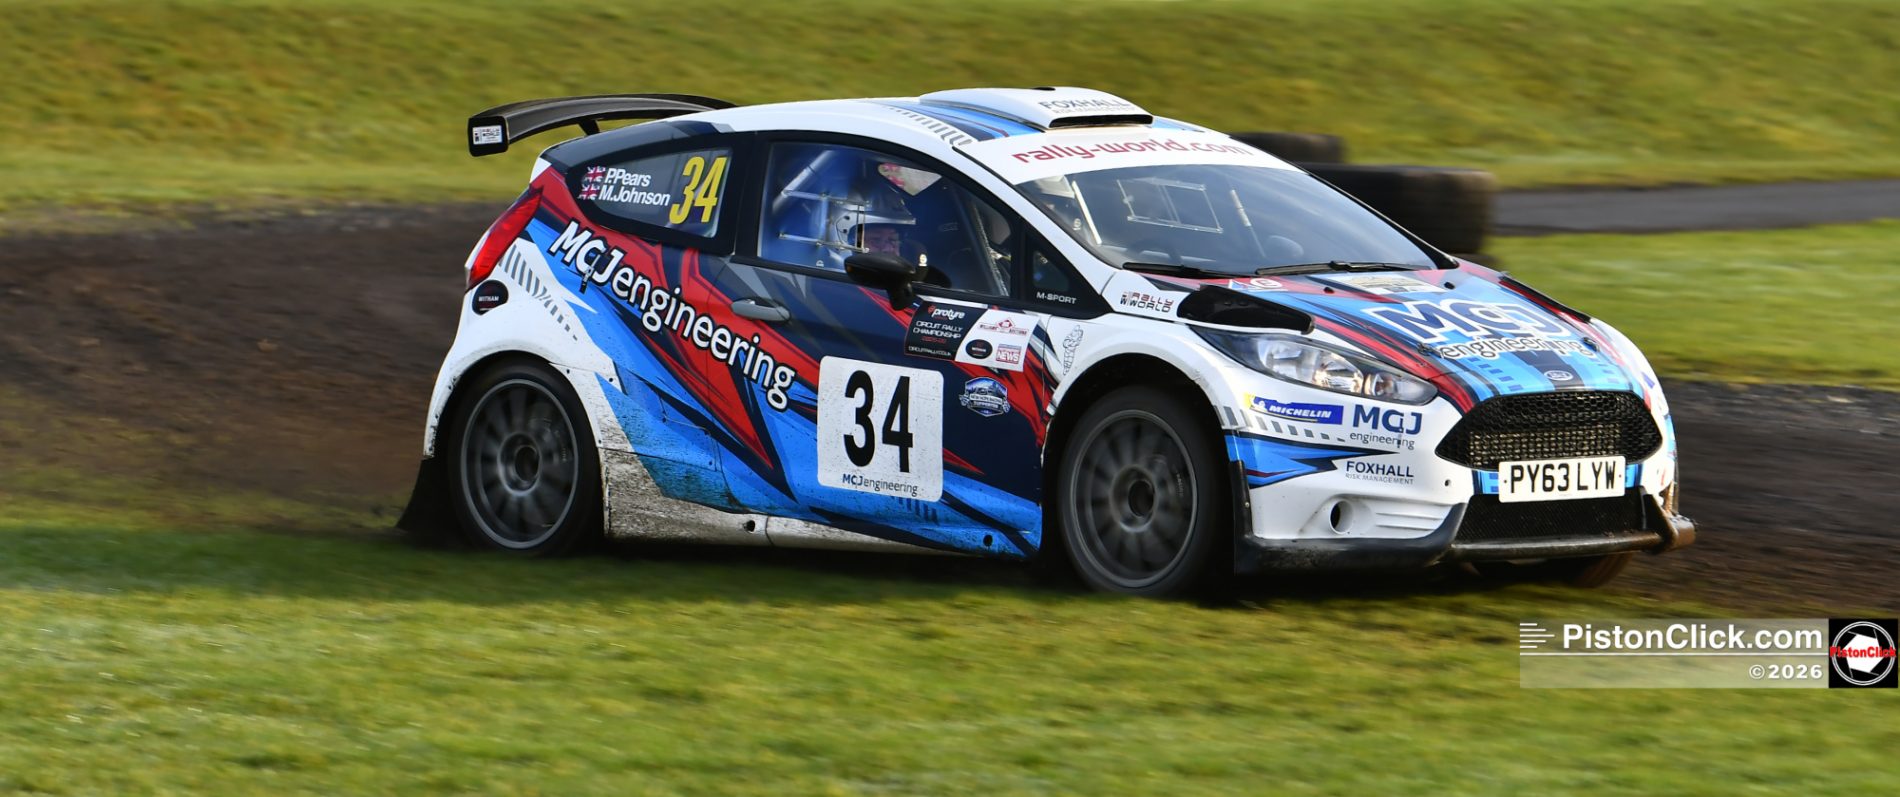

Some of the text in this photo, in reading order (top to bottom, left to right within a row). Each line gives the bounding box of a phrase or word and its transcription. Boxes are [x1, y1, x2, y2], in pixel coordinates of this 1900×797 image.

[1038, 99, 1131, 110] FOXHALL
[1012, 138, 1255, 163] rally-world.com
[604, 167, 652, 187] P.Pears
[598, 183, 671, 207] M.Johnson
[669, 155, 728, 225] 34
[1036, 291, 1078, 305] M-SPORT
[1129, 300, 1172, 313] WORLD
[931, 307, 966, 321] protyre
[1370, 302, 1568, 342] MCJ
[912, 327, 962, 339] CHAMPIONSHIP
[915, 320, 964, 332] CIRCUIT RALLY
[997, 349, 1020, 362] NEWS
[1439, 337, 1594, 359] engineering
[1268, 404, 1332, 419] MICHELIN
[1352, 403, 1422, 433] MCJ
[843, 371, 914, 472] 34
[1349, 431, 1415, 450] engineering
[1346, 460, 1414, 478] FOXHALL
[1509, 460, 1616, 494] PY63 LYW
[1345, 473, 1414, 485] RISK MANAGEMENT
